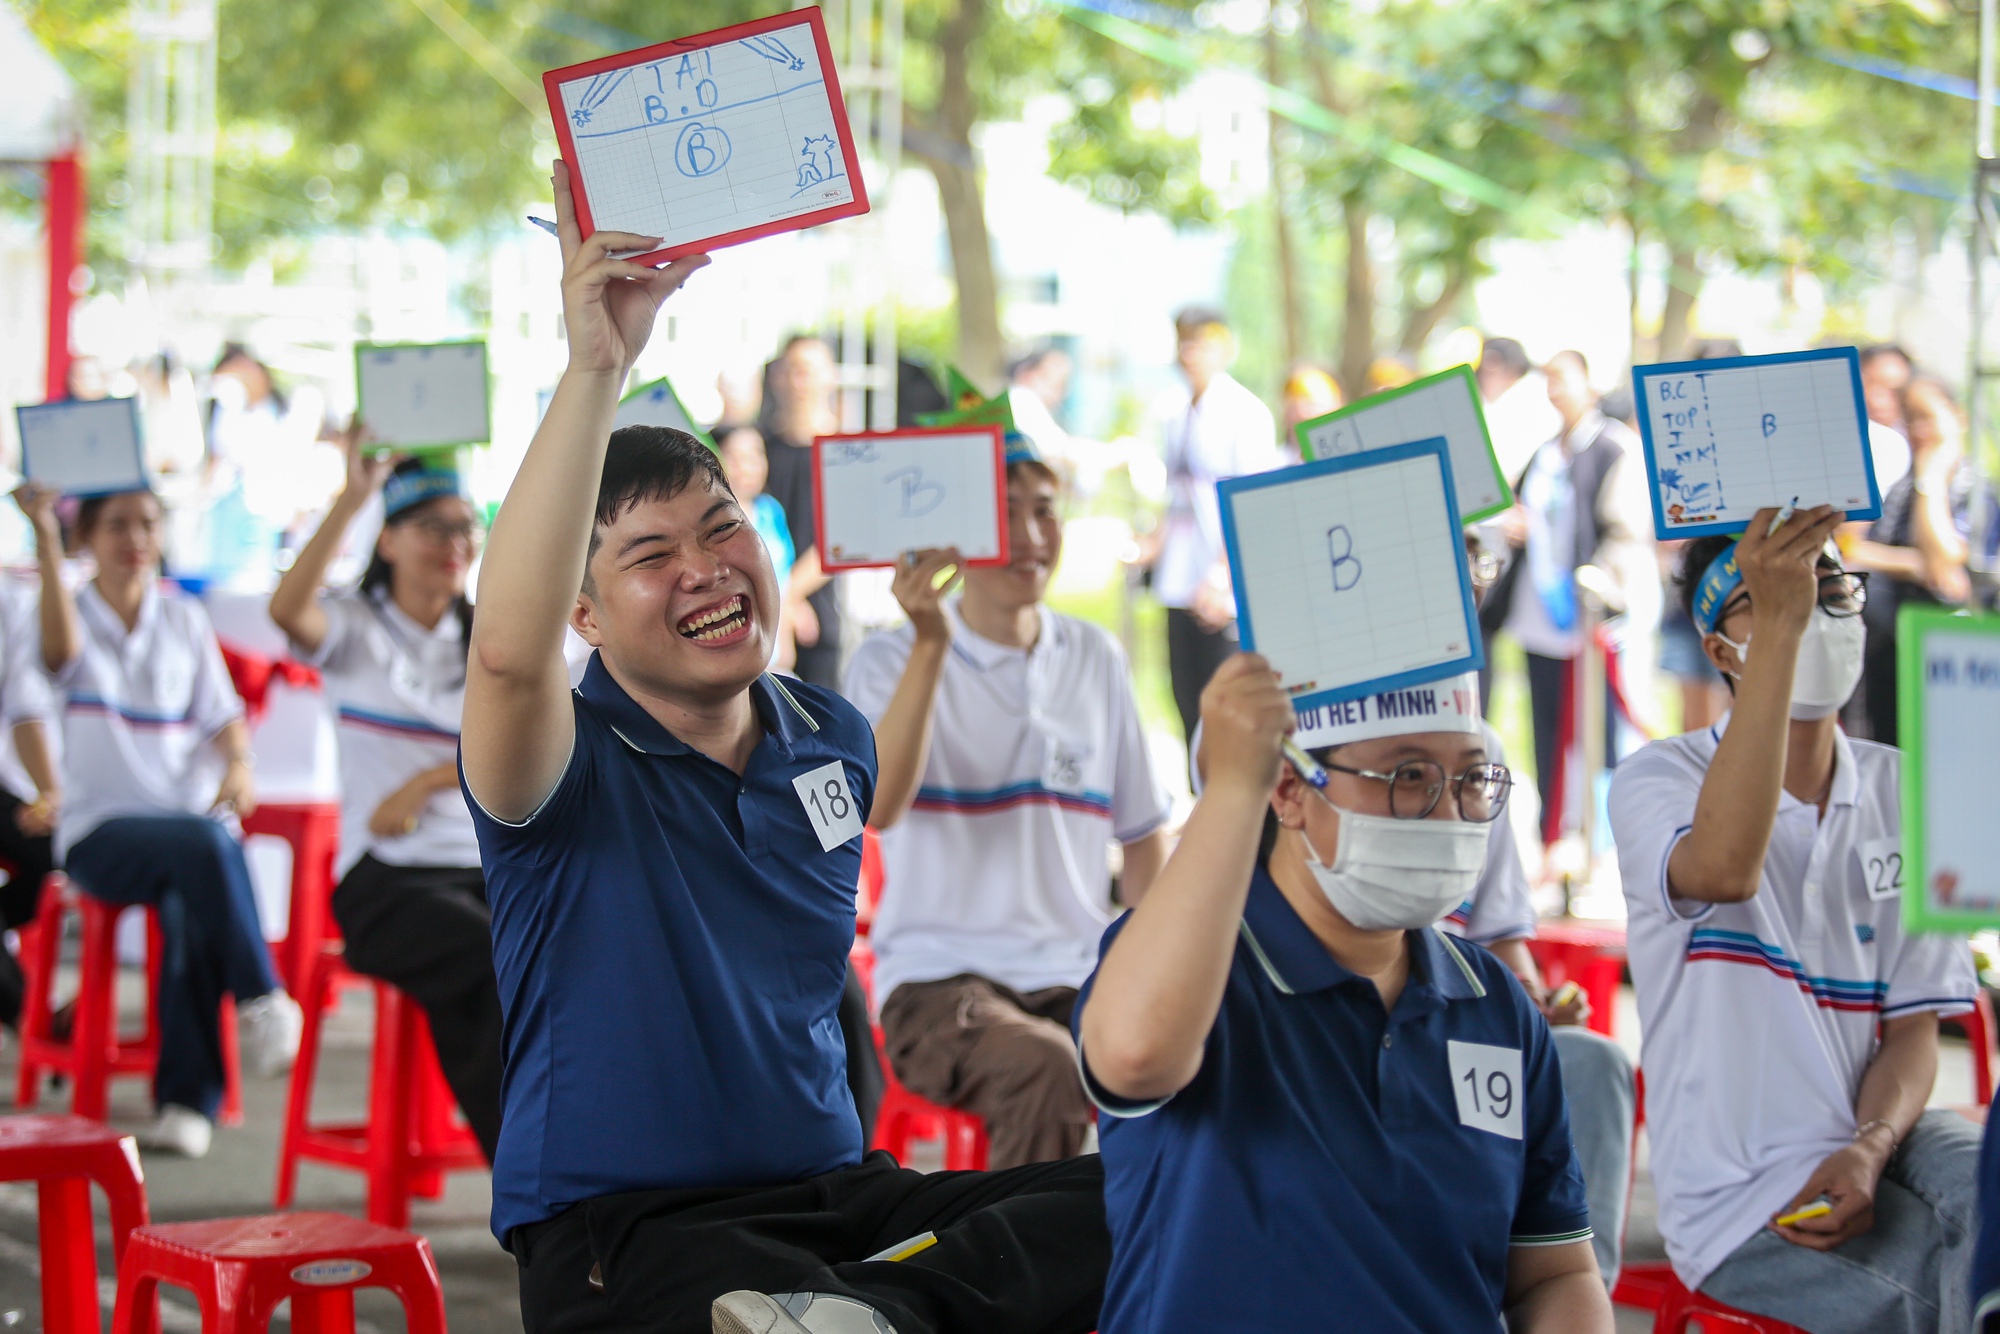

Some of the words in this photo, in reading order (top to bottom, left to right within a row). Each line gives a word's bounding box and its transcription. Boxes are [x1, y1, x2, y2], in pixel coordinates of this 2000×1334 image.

[687, 132, 717, 176] B
[1662, 406, 1697, 429] TOP
[1761, 413, 1777, 438] B
[882, 464, 947, 519] B
[1327, 524, 1363, 592] B
[809, 779, 849, 827] 18
[1868, 851, 1907, 893] 22
[1463, 1066, 1513, 1119] 19
